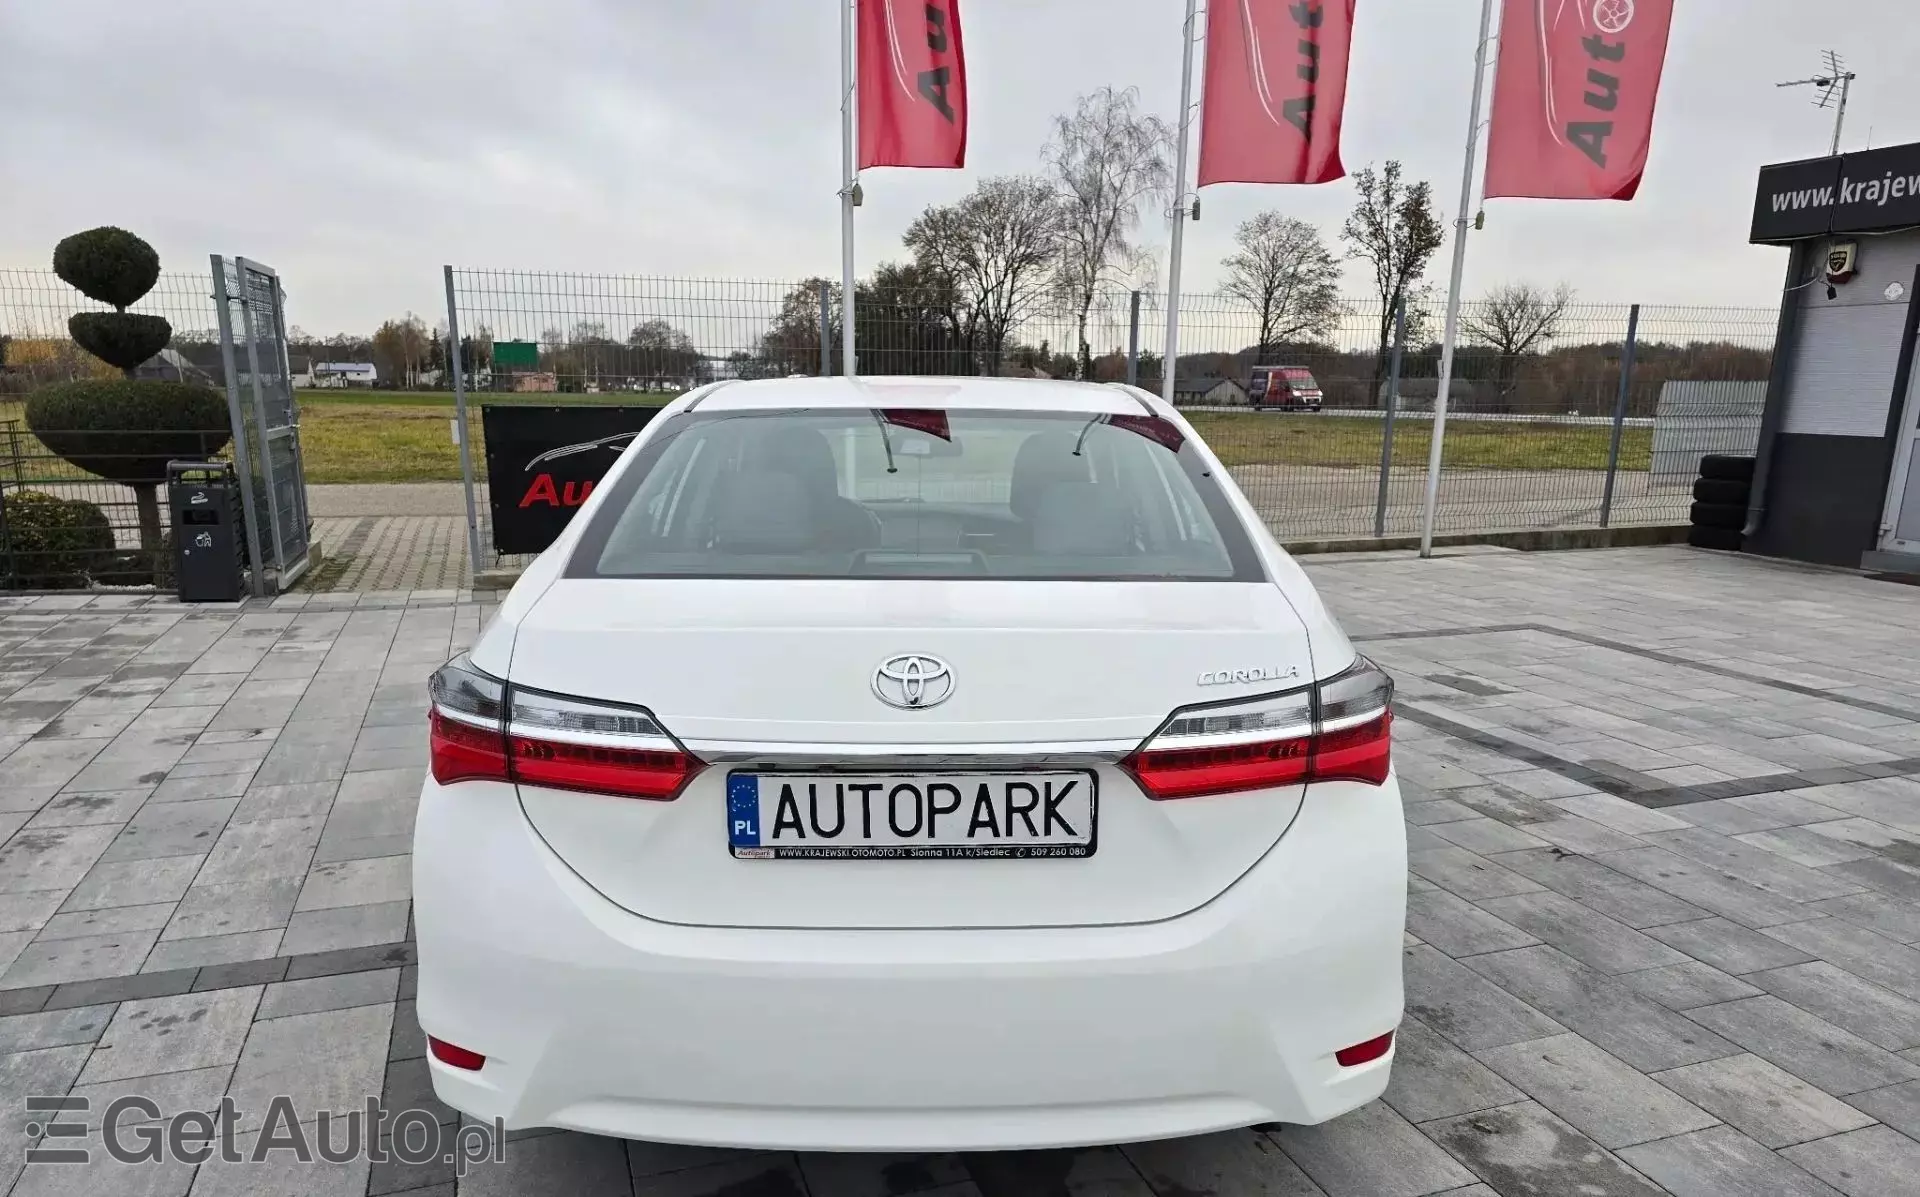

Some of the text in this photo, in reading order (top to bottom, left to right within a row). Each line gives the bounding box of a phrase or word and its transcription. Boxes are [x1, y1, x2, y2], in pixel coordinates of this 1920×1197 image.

[1197, 665, 1299, 686] COROLLA
[772, 781, 1079, 838] AUTOPARK
[734, 820, 756, 835] PL
[779, 848, 906, 857] WWW.KRAJEWSKI.OTOMOTO.PL
[946, 848, 964, 857] 11A
[1030, 848, 1047, 857] 509
[1049, 848, 1067, 857] 260
[1069, 847, 1086, 856] 080
